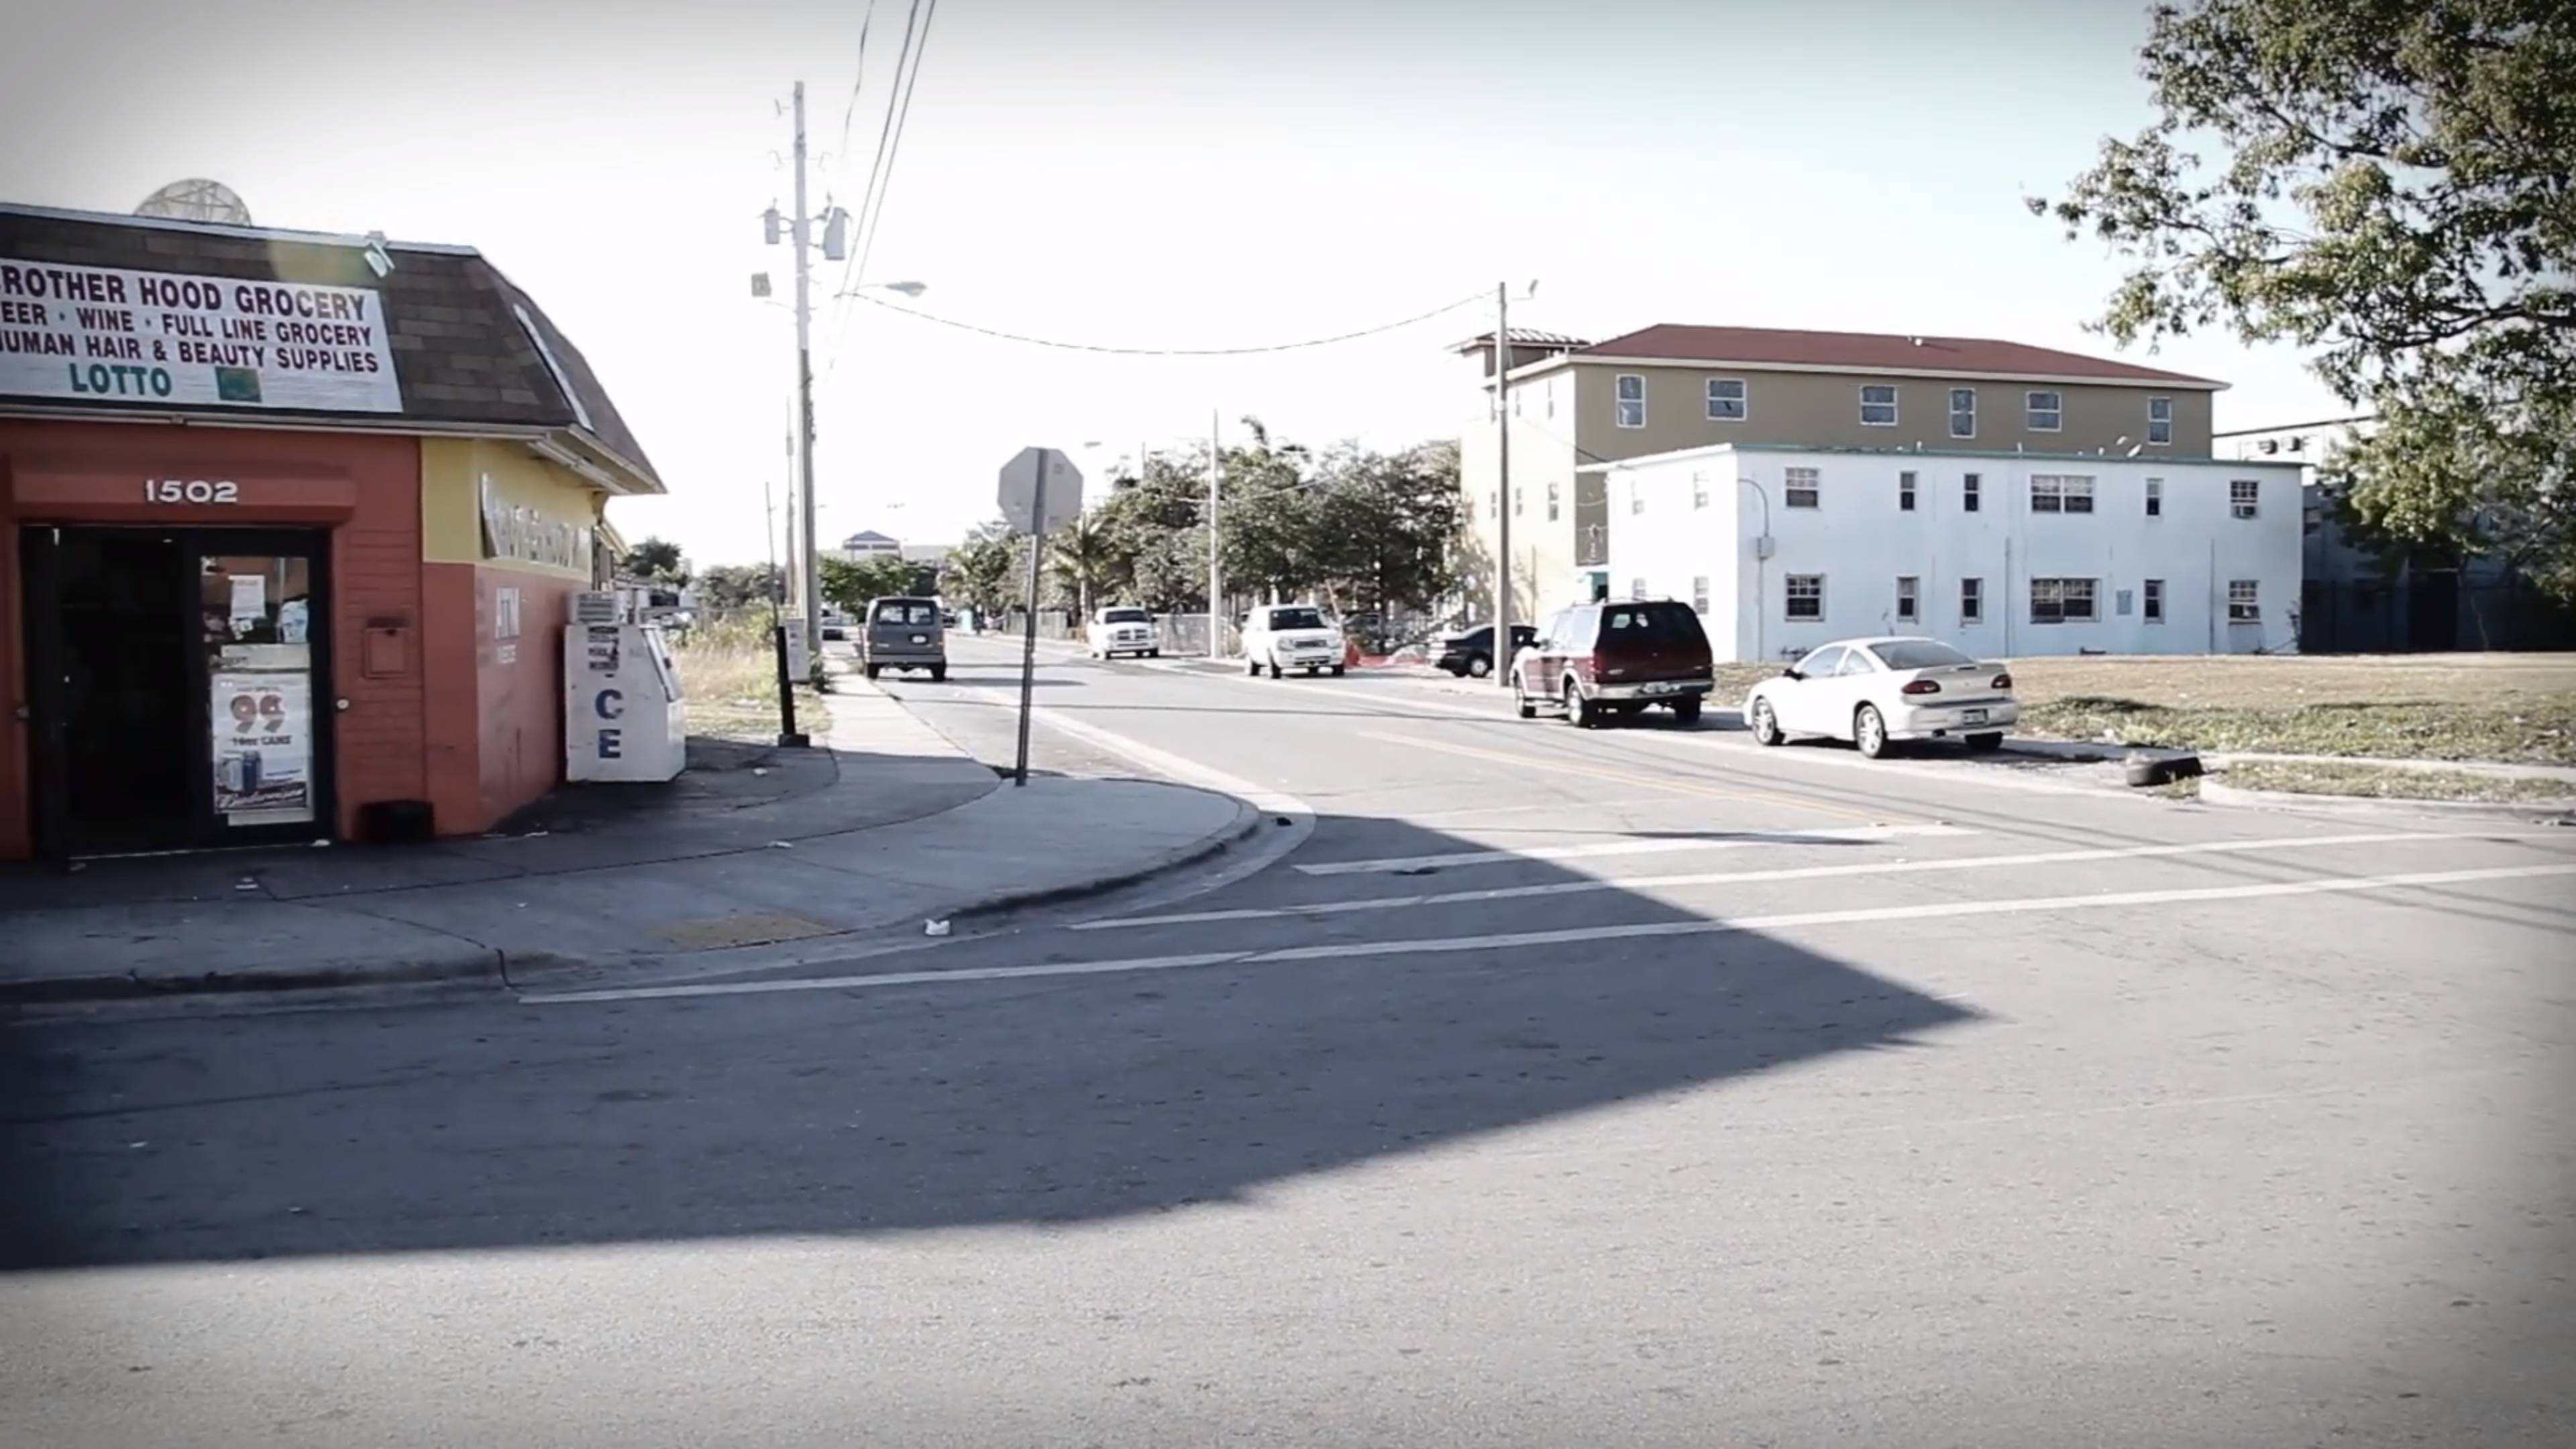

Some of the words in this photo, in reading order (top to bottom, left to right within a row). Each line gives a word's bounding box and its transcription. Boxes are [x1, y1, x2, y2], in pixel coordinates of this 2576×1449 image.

[0, 265, 127, 303] ROTHER
[138, 276, 222, 310] HOOD
[235, 285, 365, 321] GROCERY
[0, 301, 48, 326] EER
[76, 307, 134, 332] WINE
[162, 313, 213, 337] FULL
[221, 318, 267, 341] LINE
[275, 321, 371, 347] GROCERY
[85, 335, 142, 360] HAIR
[152, 339, 168, 362] &
[178, 341, 264, 368] BEAUTY
[276, 347, 380, 373] SUPPLIES
[69, 362, 172, 397] LOTTO
[146, 480, 238, 502] 1502
[595, 656, 625, 759] CE
